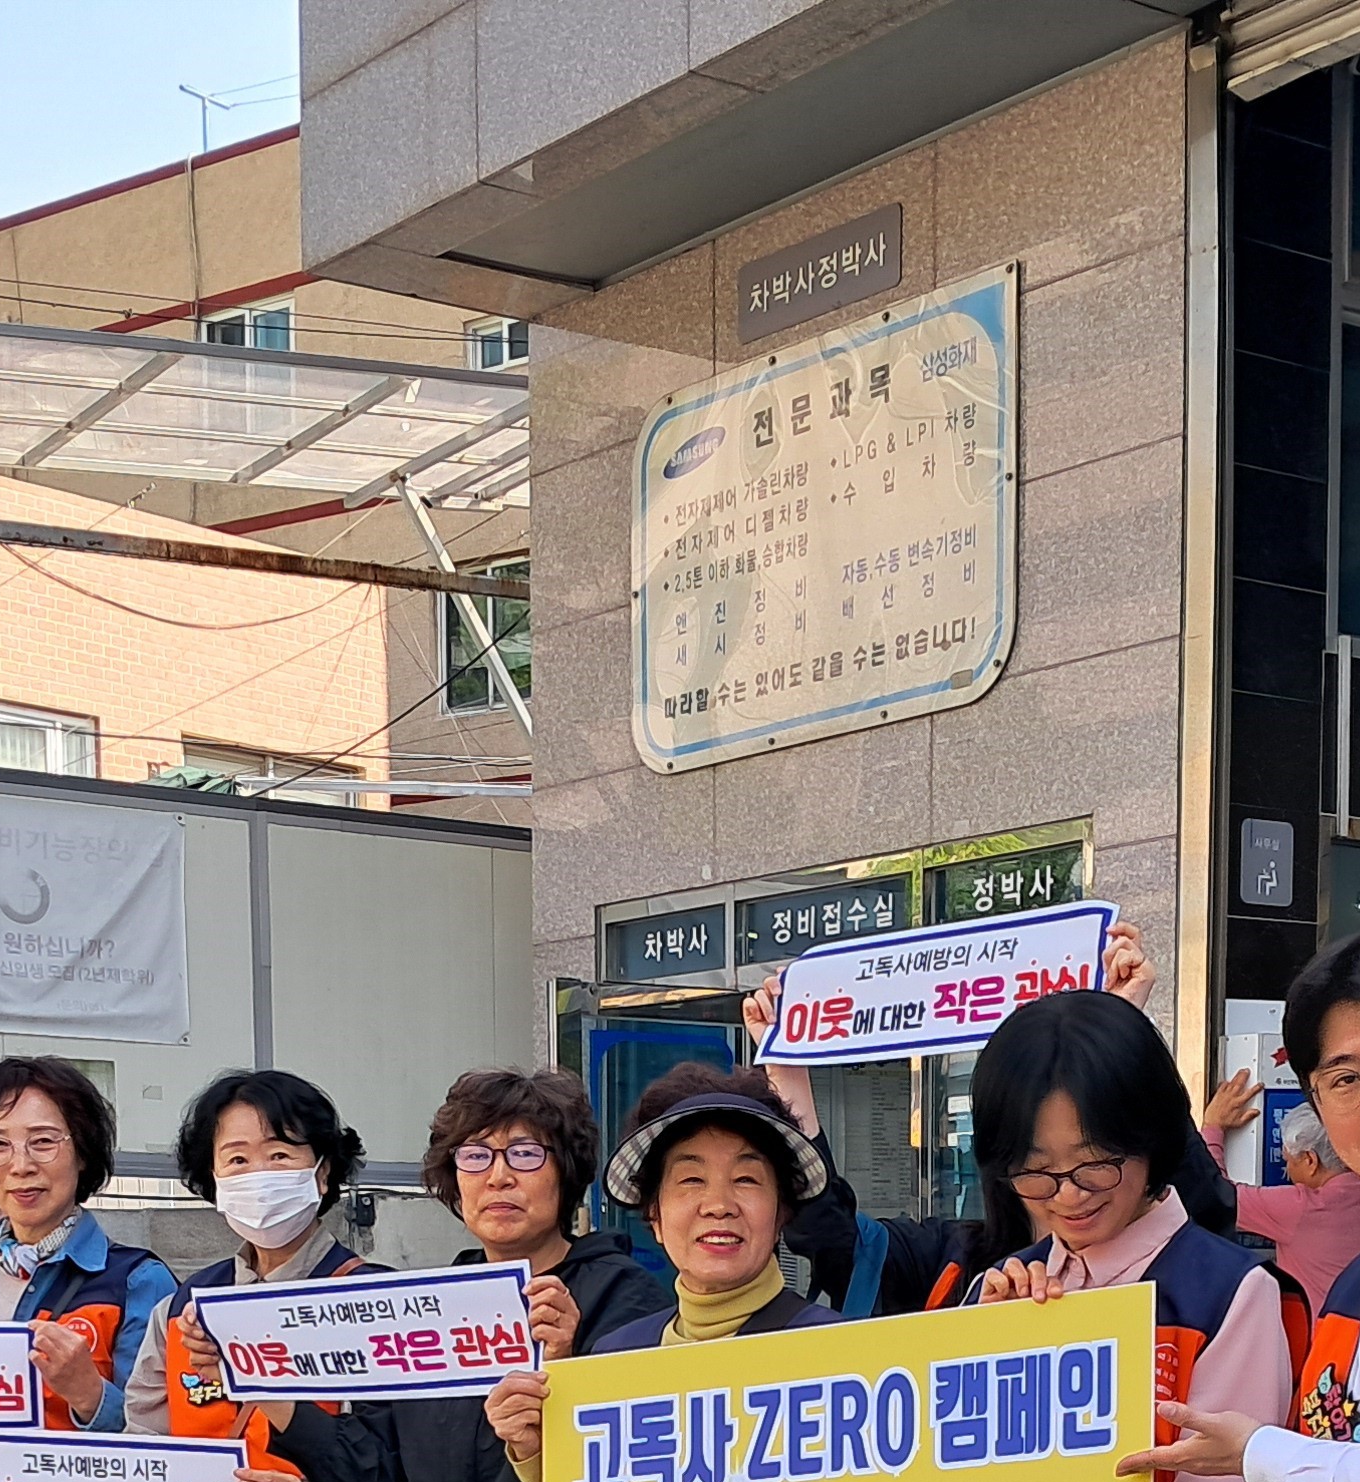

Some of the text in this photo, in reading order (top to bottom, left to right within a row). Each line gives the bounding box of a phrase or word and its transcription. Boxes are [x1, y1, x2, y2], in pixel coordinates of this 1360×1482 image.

[749, 232, 888, 314] 차박사정박사
[922, 336, 977, 382] 삼성화재
[670, 438, 719, 467] SAMSUNG
[843, 402, 977, 469] LPG & LPI 차량
[744, 461, 808, 503] 가솔린차량
[675, 496, 808, 561] 전자제어 디젤차량
[907, 523, 977, 568] 변속기정비
[708, 556, 730, 583] 이하
[664, 687, 709, 719] 따라할
[717, 679, 747, 707] 수는
[755, 662, 802, 698] 있어도
[853, 641, 885, 672] 수는
[895, 616, 976, 661] 없습니다!
[971, 866, 1055, 912] 정박사
[771, 891, 896, 944] 정비접수실
[4, 931, 115, 959] 원하십니까?
[644, 921, 708, 962] 차박사
[854, 936, 1019, 983] 고독사예방의 시작
[786, 996, 875, 1044] 이웃에
[881, 1003, 926, 1032] 대한
[932, 975, 1004, 1026] 작은
[277, 1294, 442, 1330] 고독사예방의 시작
[228, 1322, 530, 1379] 이웃에 대한 작은 관심
[933, 1341, 1117, 1468] 캠페인
[22, 1453, 168, 1481] 고독사예방의 시작
